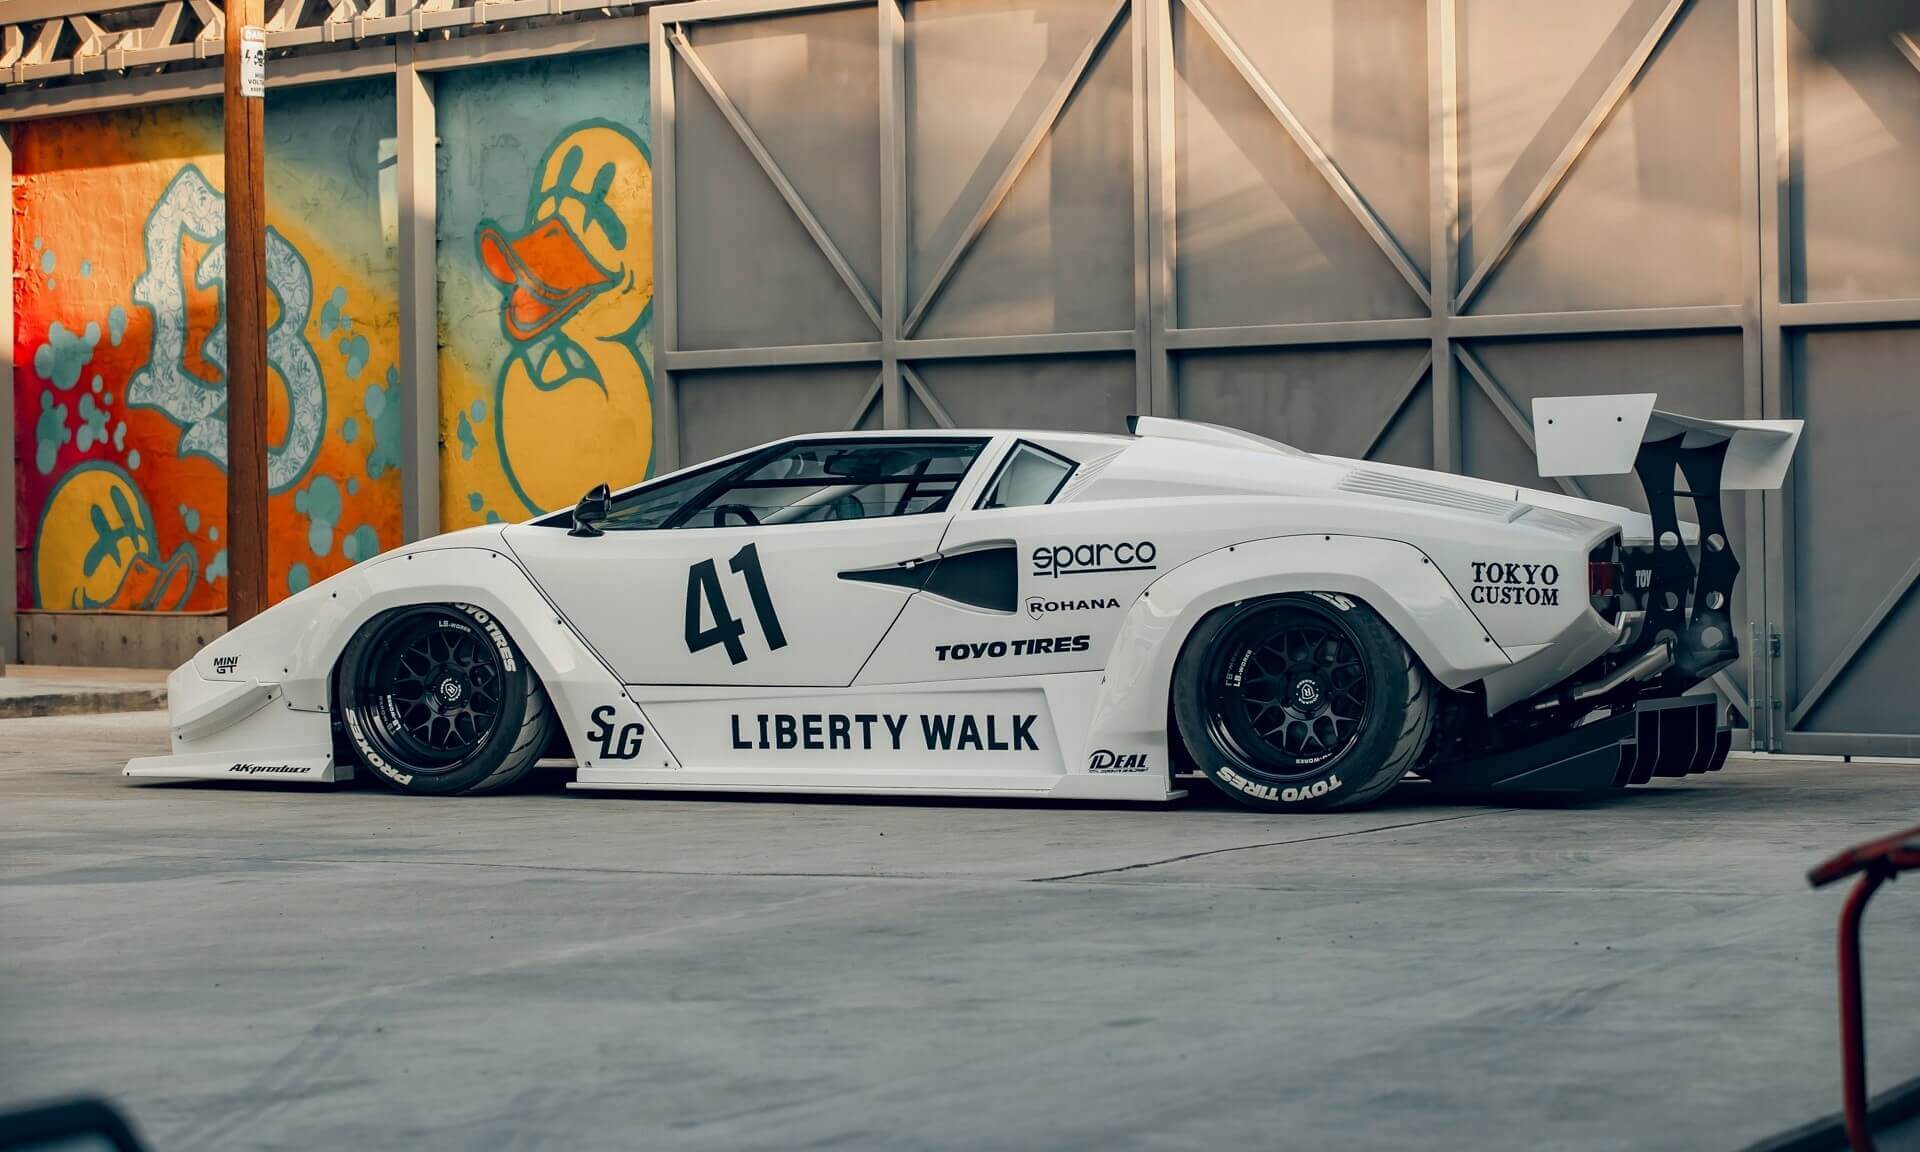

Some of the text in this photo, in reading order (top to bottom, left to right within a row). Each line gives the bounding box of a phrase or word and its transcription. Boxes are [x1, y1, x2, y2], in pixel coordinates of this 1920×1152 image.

[1032, 541, 1156, 578] sparco
[1471, 562, 1559, 585] TOKYO
[1635, 569, 1653, 588] TOY
[685, 542, 788, 666] 41
[1029, 598, 1120, 613] ROHANA
[1470, 586, 1559, 606] CUSTOM
[485, 620, 516, 672] TIRES
[935, 634, 1091, 661] TOYO TIRES
[213, 656, 239, 666] MINI
[216, 664, 237, 674] GT
[345, 707, 413, 785] PROXES
[587, 705, 645, 760] SLG
[731, 714, 1041, 751] LIBERTY WALK
[228, 763, 312, 774] AKproduce
[1216, 766, 1343, 802] TOYO TIRES
